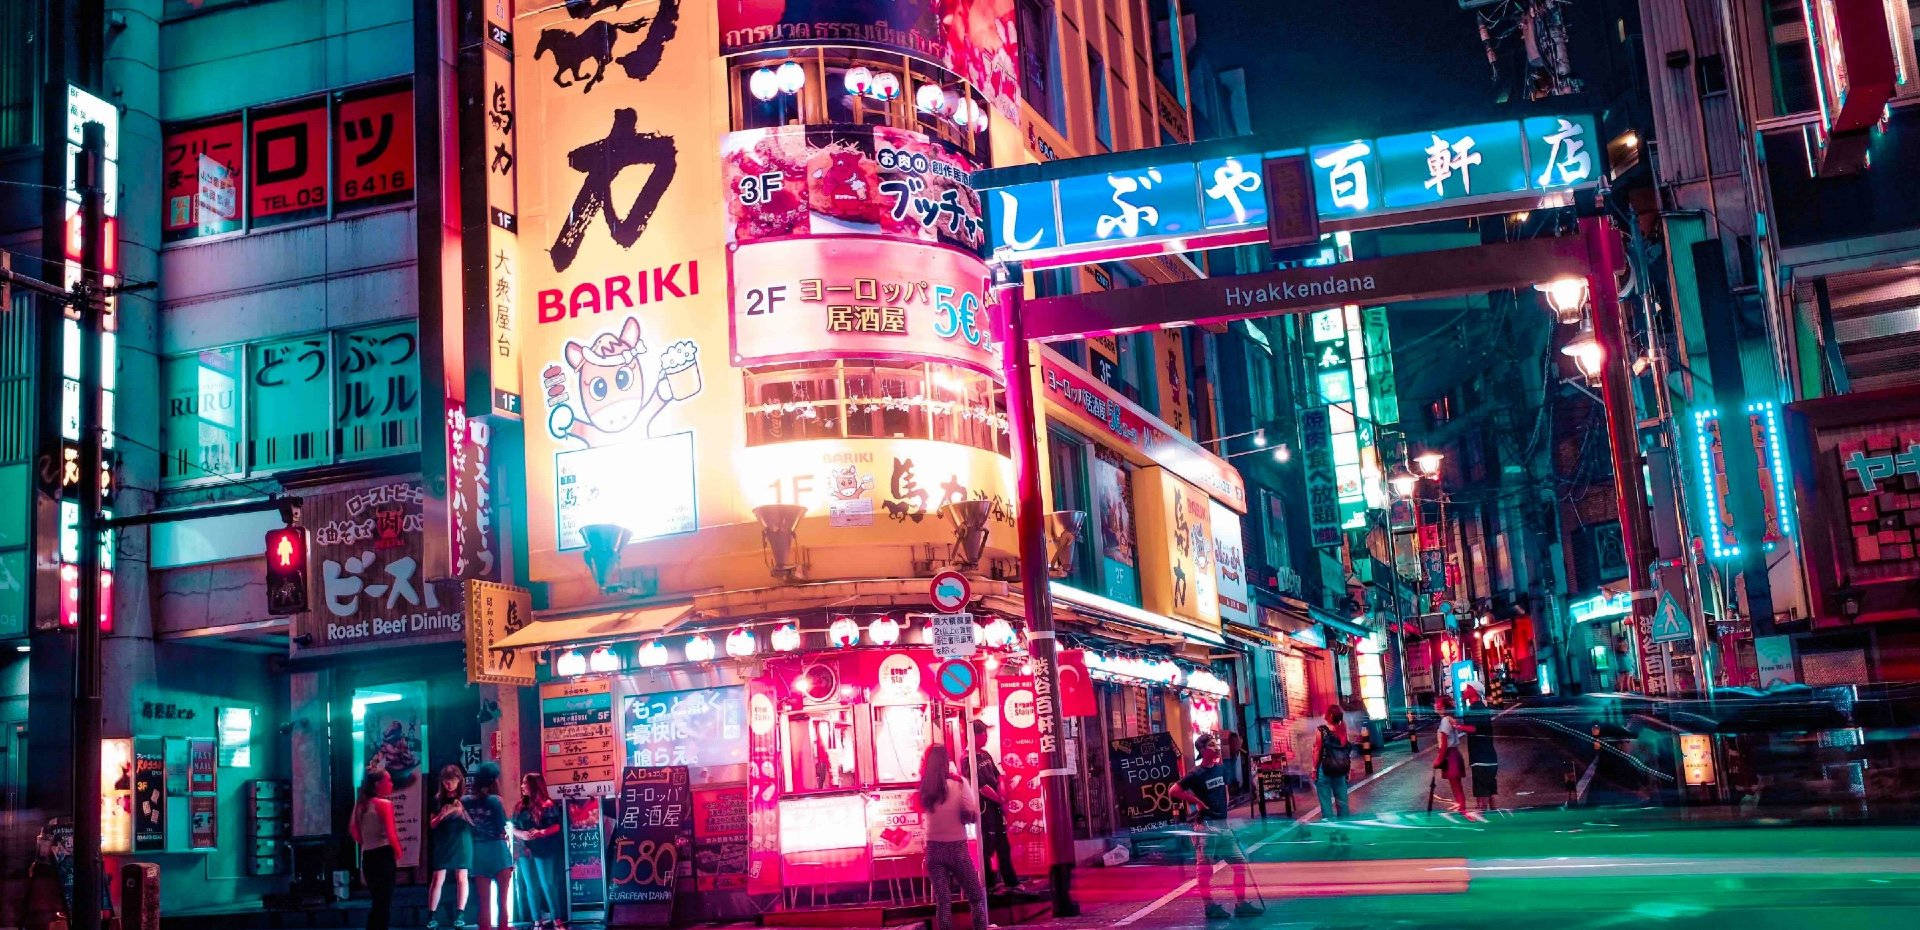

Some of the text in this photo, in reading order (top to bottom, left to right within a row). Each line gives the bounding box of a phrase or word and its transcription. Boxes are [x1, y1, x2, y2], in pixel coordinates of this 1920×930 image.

[494, 28, 507, 44] 2F
[489, 81, 513, 175] 馬力
[167, 140, 232, 166] フリー
[879, 149, 972, 186] お肉の 創作居酒
[345, 171, 405, 197] 6416
[740, 172, 784, 205] 3F
[1001, 119, 1595, 252] しぶや百軒店
[496, 212, 512, 229] 1F
[880, 179, 984, 241] ブッチャ
[537, 260, 700, 324] BARIKI
[746, 286, 787, 316] 2F
[800, 278, 928, 304] ヨーロッパ
[1225, 272, 1377, 307] Hyakkendana
[827, 306, 907, 333] 居酒屋
[256, 332, 416, 388] どうぶつ
[1098, 359, 1114, 389] 3F
[170, 390, 234, 418] RURU
[339, 375, 418, 422] ルル
[502, 394, 516, 412] 1F
[823, 452, 873, 463] BARIKI
[469, 420, 493, 576] ローストビーフ
[768, 474, 814, 506] 1F
[1173, 485, 1190, 608] 馬力
[328, 611, 462, 641] Roast Beef Dining
[1032, 657, 1056, 753] 渋谷百軒店
[137, 782, 148, 790] 3F
[1127, 765, 1171, 783] FOOD
[626, 786, 683, 803] ヨーロッパ
[1141, 782, 1174, 814] 58
[620, 804, 682, 829] 居酒屋
[612, 839, 677, 886] 580
